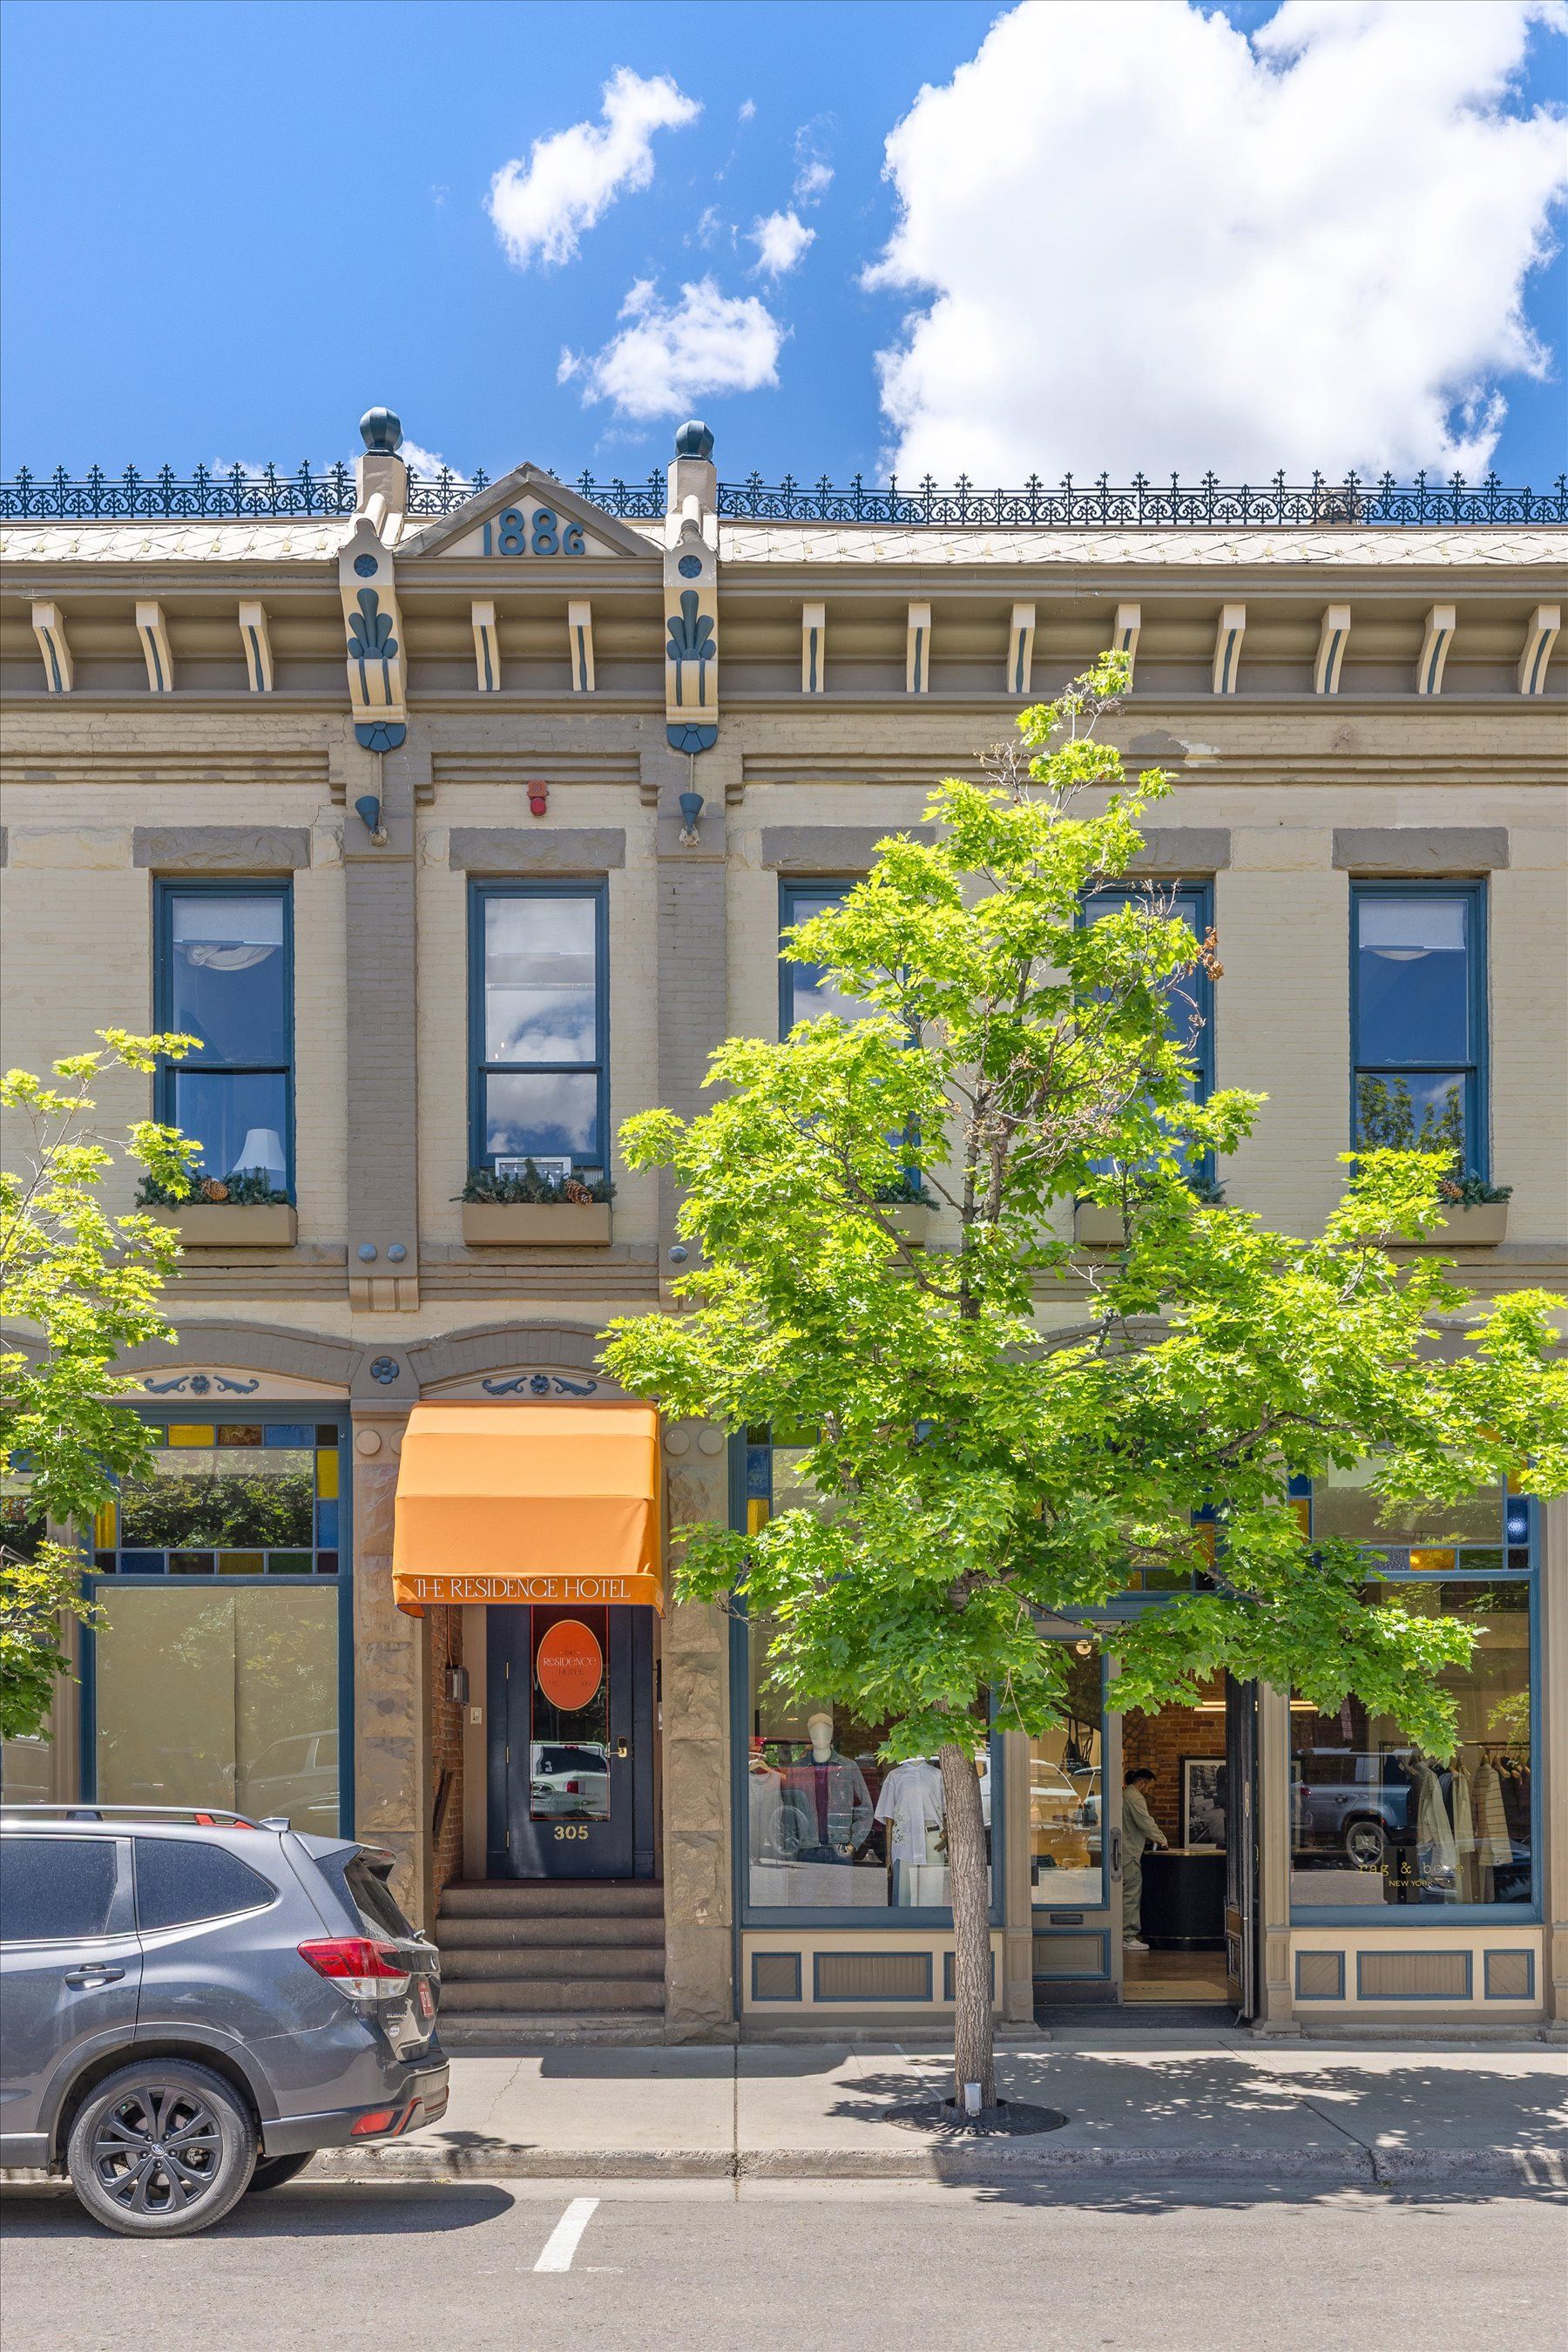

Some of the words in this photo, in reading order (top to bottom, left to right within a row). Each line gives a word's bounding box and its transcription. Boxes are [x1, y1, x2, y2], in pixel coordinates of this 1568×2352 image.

[483, 508, 585, 556] 1886
[414, 1578, 444, 1598] THE
[450, 1578, 558, 1598] RESIDENCE
[564, 1578, 631, 1598] HOTEL
[554, 1825, 589, 1840] 305
[1357, 1863, 1389, 1876] rag
[1400, 1862, 1412, 1875] &
